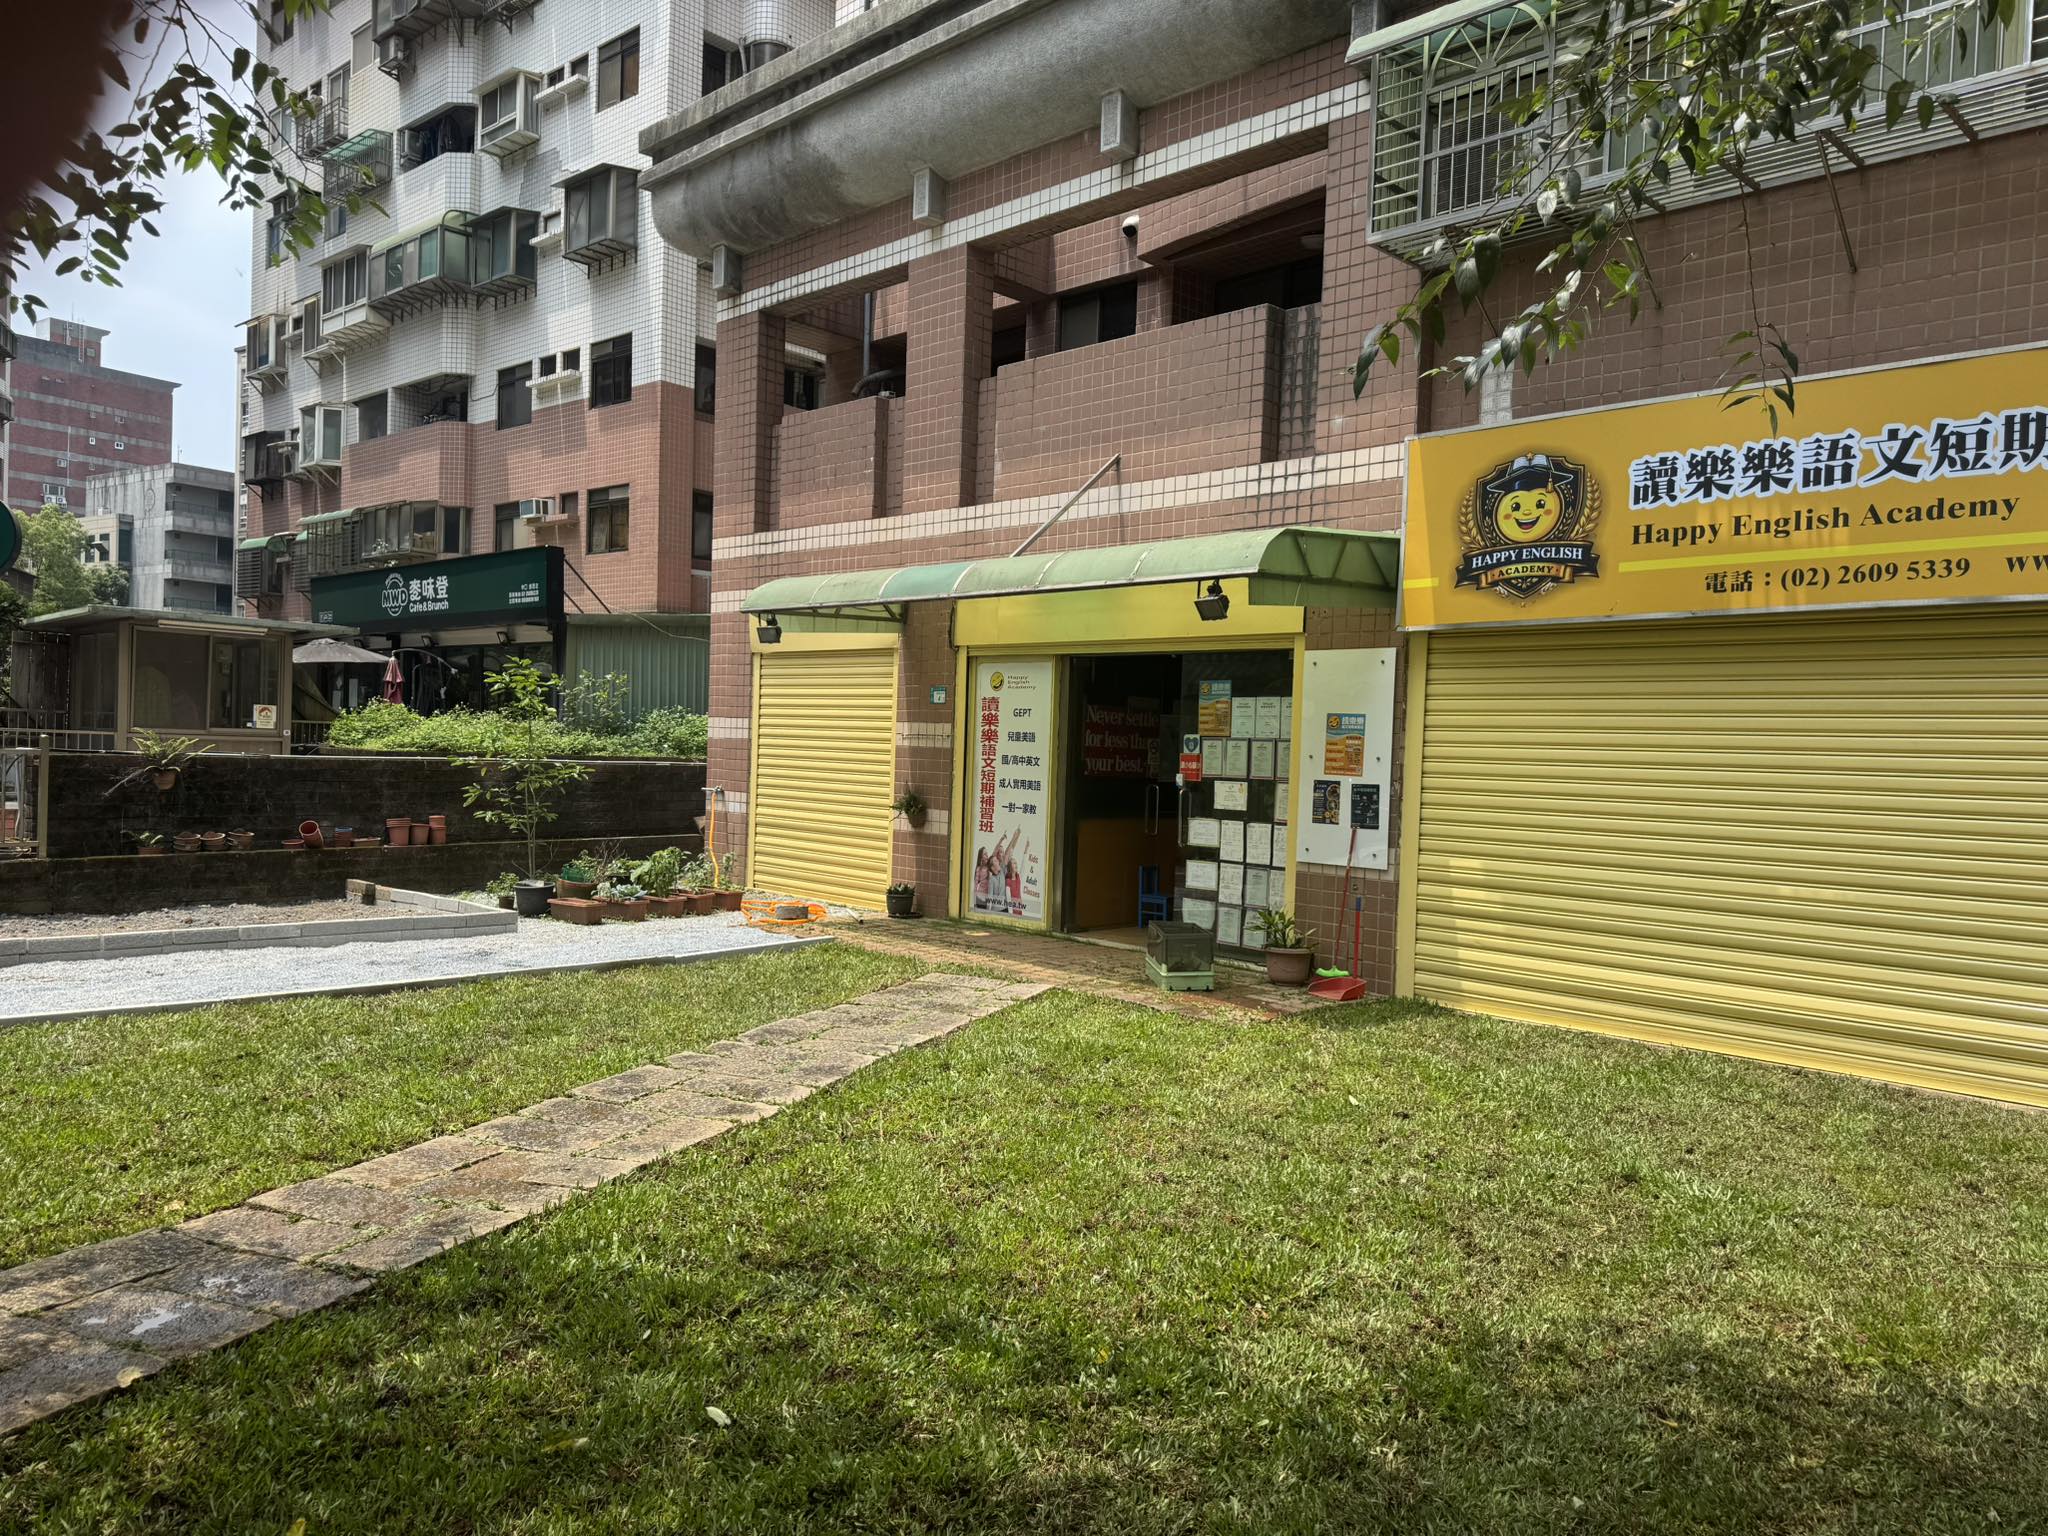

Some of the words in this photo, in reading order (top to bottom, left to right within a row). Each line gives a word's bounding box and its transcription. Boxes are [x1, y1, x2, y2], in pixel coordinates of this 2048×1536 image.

[1632, 411, 2048, 506] 讀樂樂語文短期
[1631, 523, 1723, 547] Happy
[1731, 506, 1850, 538] English
[1859, 497, 2021, 527] Academy
[1472, 549, 1519, 568] HAPPY
[1522, 547, 1583, 560] ENGLISH
[1498, 565, 1554, 577] ACADEMY
[1837, 562, 1899, 584] 2609
[1906, 557, 1971, 580] 5339
[381, 588, 408, 608] MWD
[409, 575, 449, 601] 麥味登
[1013, 708, 1032, 717] GEPT
[1086, 704, 1124, 725] Never
[1007, 731, 1036, 743] 兒童美語
[1084, 728, 1105, 747] for
[1105, 731, 1129, 749] less
[979, 696, 1000, 833] 讀樂樂語文短期補習班
[1084, 757, 1115, 775] your
[1001, 802, 1037, 815] 一對一家教
